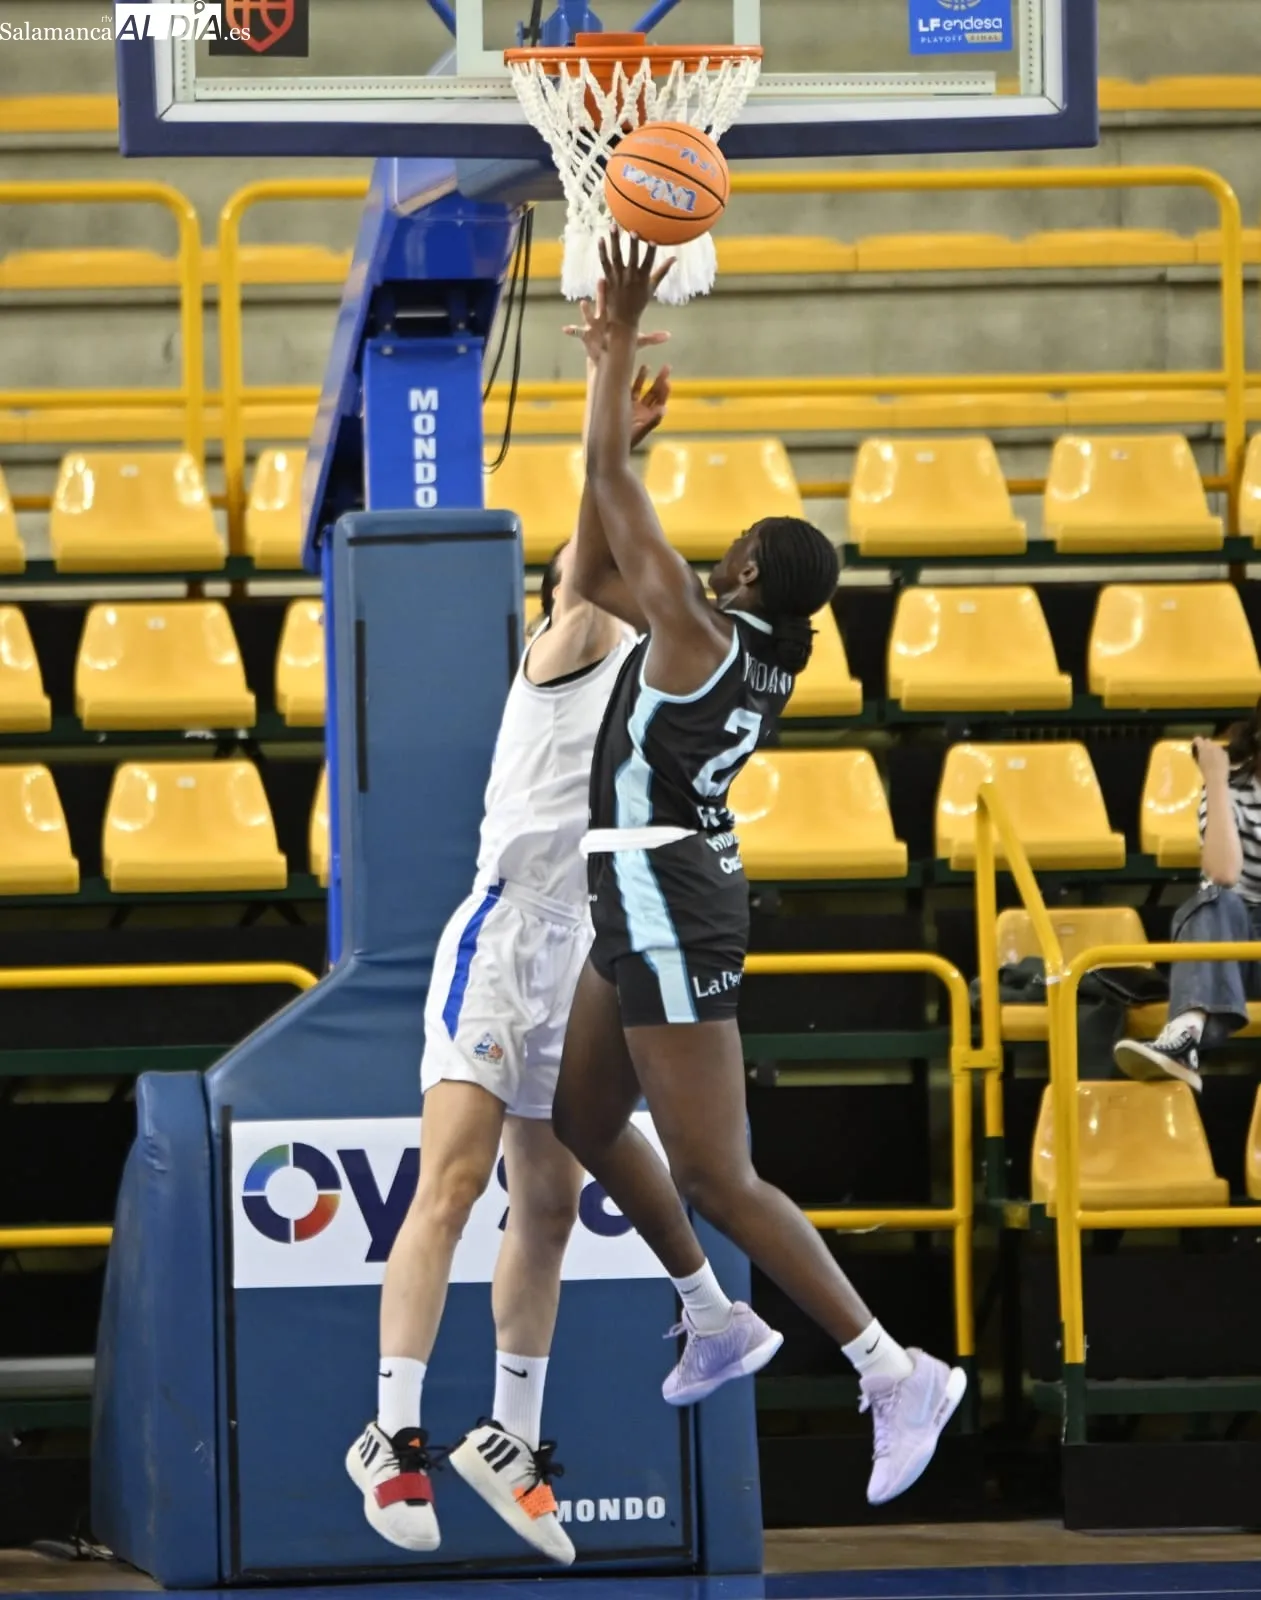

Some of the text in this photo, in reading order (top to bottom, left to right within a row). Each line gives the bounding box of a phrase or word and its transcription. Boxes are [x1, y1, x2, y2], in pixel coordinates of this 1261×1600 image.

[918, 16, 1003, 32] LF endesa
[409, 388, 438, 508] MONDO
[692, 707, 762, 797] 2
[556, 1496, 666, 1522] MONDO
